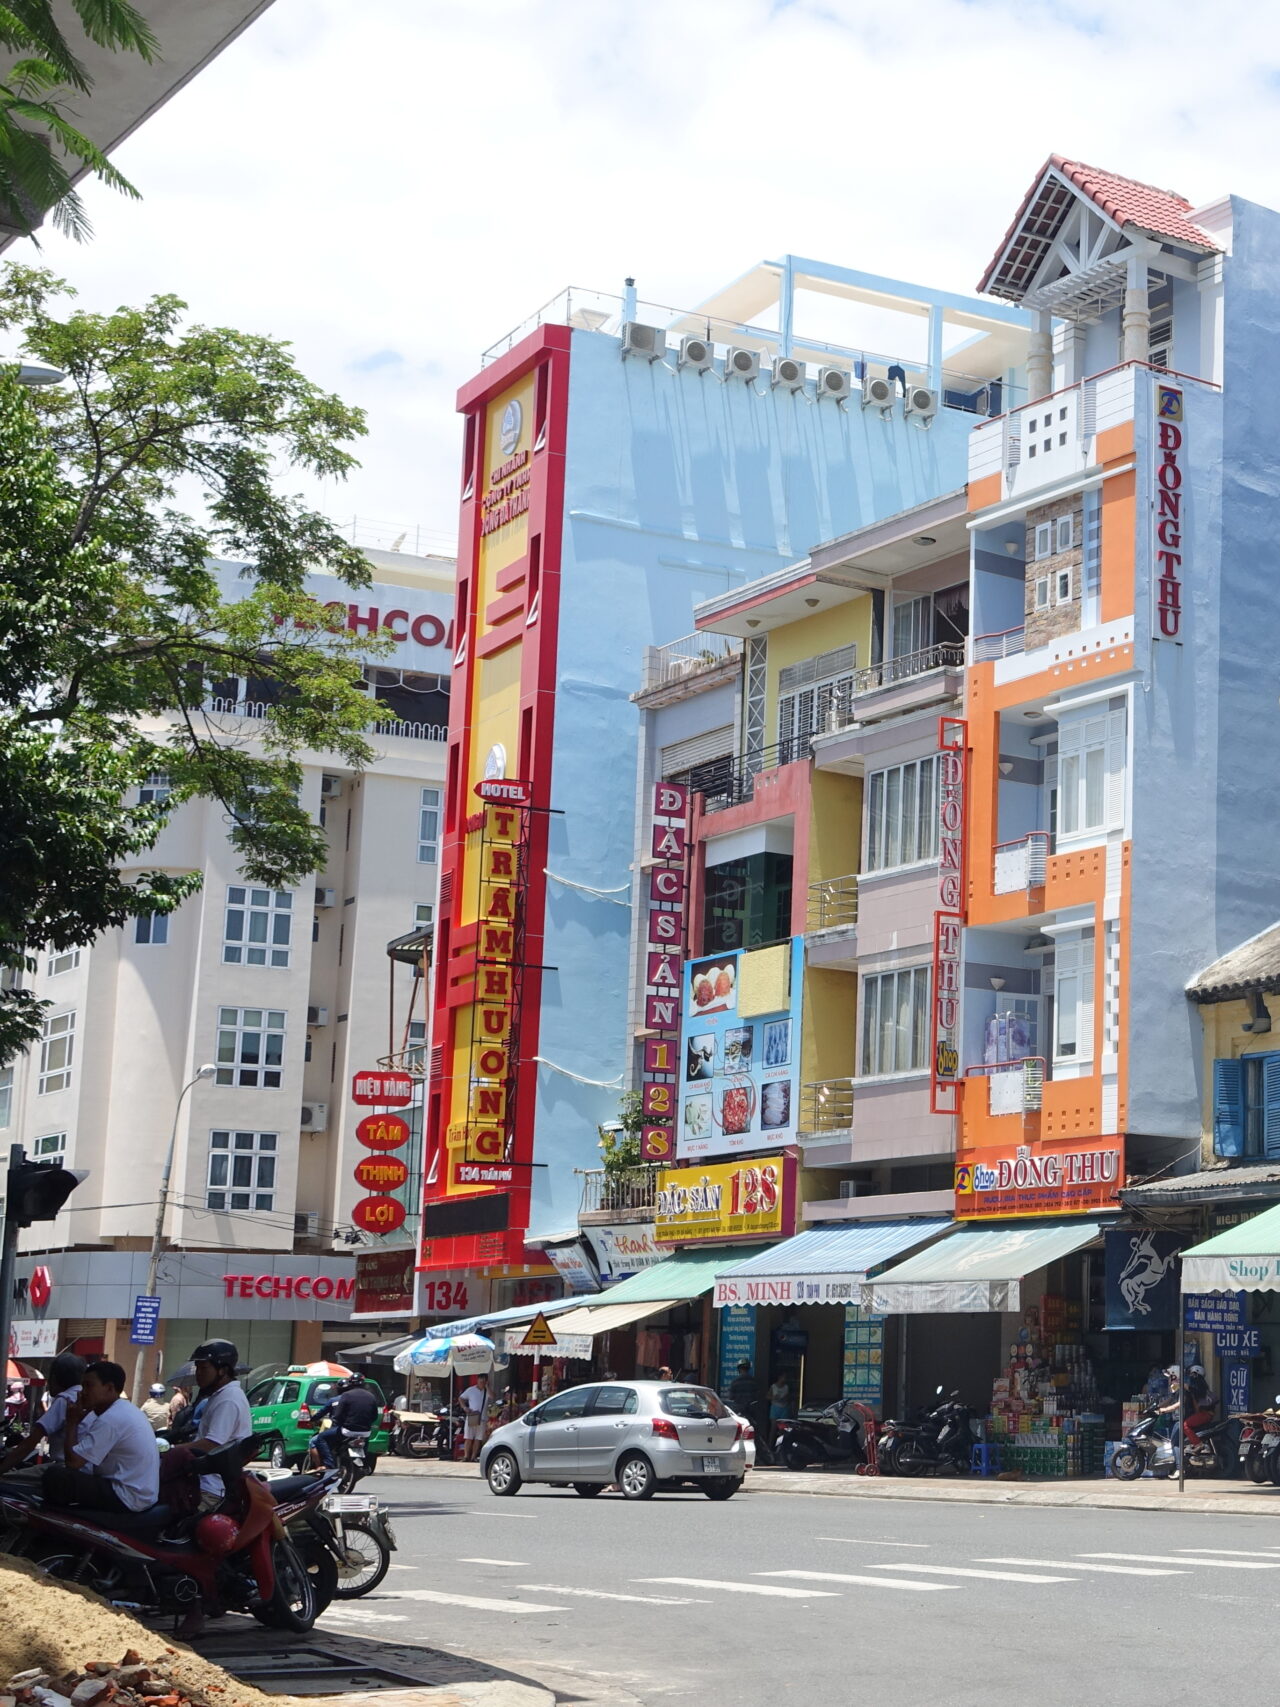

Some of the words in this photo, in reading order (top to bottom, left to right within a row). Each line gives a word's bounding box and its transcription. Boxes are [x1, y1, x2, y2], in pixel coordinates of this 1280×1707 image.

[1158, 550, 1182, 637] THU
[481, 783, 526, 800] HOTEL
[656, 788, 683, 895] ĐẶC
[652, 914, 676, 1025] SẢN
[939, 922, 960, 1029] THU
[936, 1041, 958, 1076] Shop
[645, 1043, 672, 1157] 128
[366, 1121, 402, 1141] TÂM
[360, 1165, 404, 1184] THỊNH
[460, 1166, 480, 1181] 134
[974, 1164, 995, 1190] Shop
[1065, 1150, 1115, 1184] THU
[728, 1165, 779, 1216] 128
[365, 1203, 394, 1225] LỢI
[1229, 1259, 1269, 1281] Shop
[425, 1280, 469, 1310] 134
[717, 1283, 741, 1302] BS.
[747, 1281, 792, 1301] MINH
[1242, 1330, 1259, 1347] XE
[1231, 1388, 1245, 1406] XE
